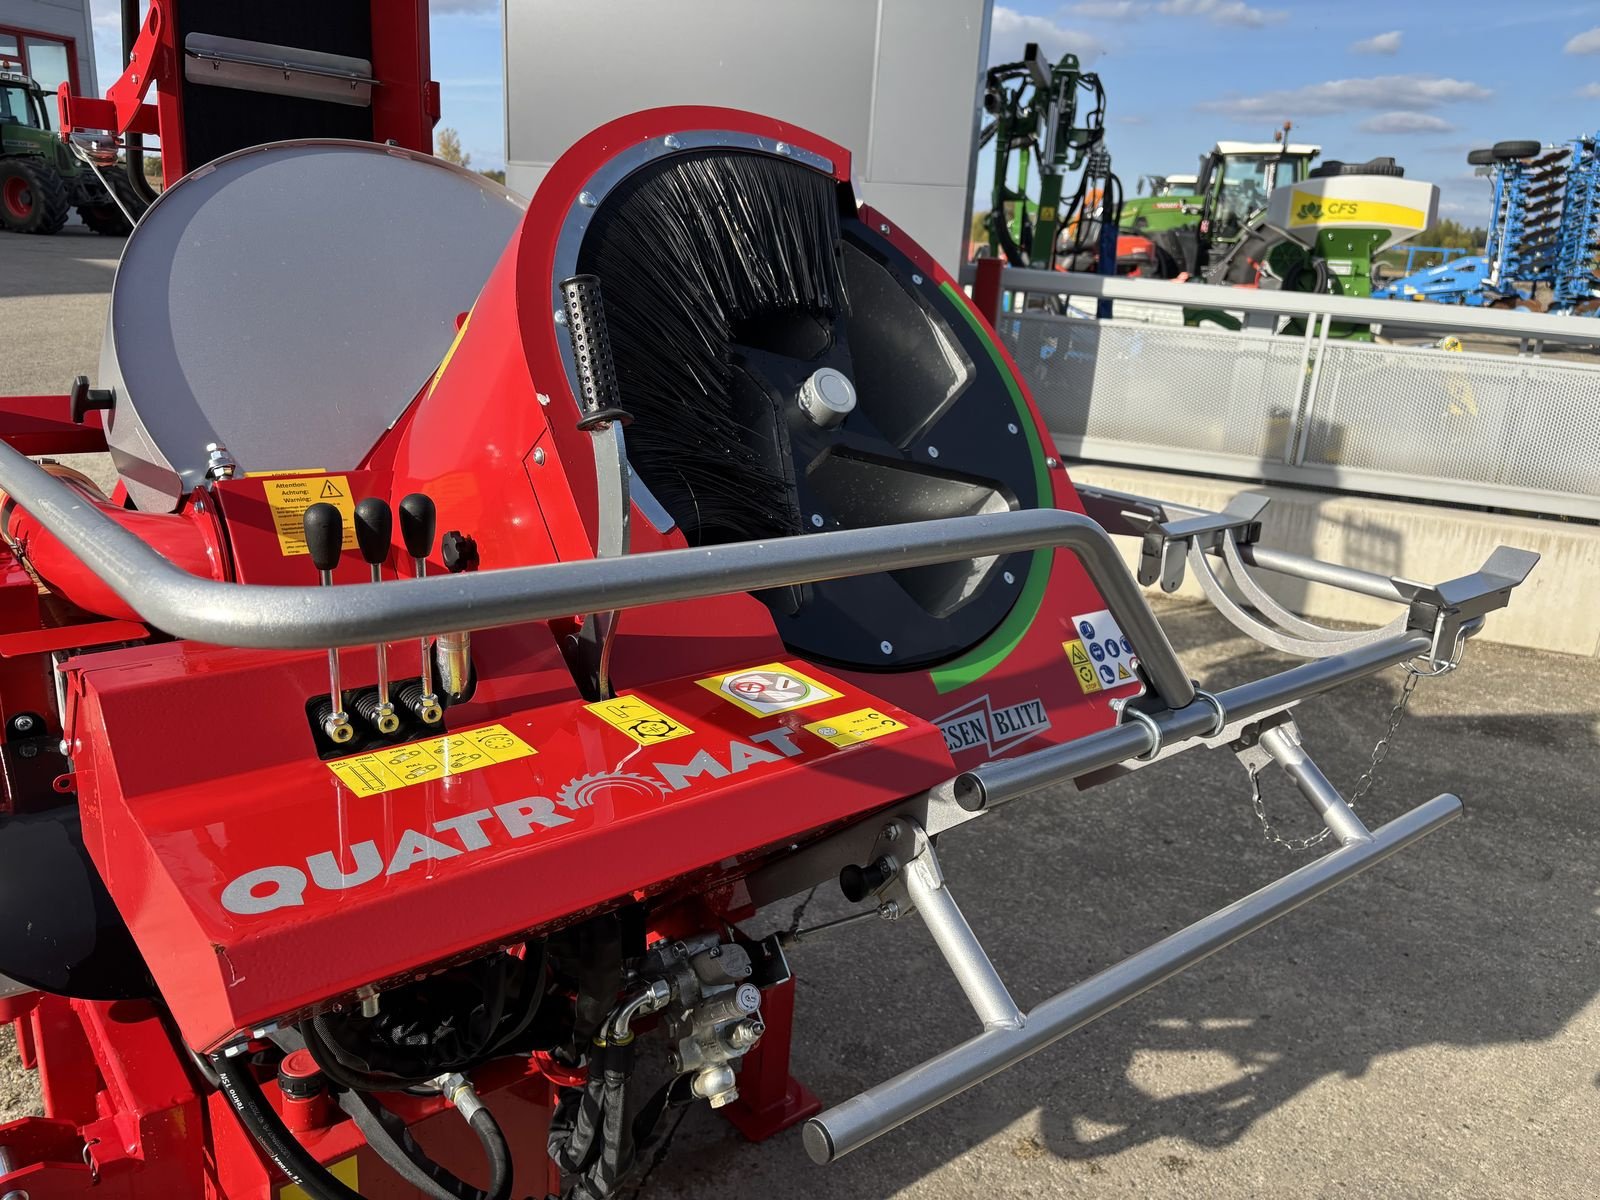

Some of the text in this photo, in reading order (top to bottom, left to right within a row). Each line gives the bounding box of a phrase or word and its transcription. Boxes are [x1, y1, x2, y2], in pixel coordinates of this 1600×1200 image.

[1328, 203, 1359, 215] CFS
[1085, 683, 1098, 691] STOP
[992, 700, 1047, 735] BLITZ
[219, 1073, 231, 1089] 1SN
[229, 1089, 245, 1111] Tekno
